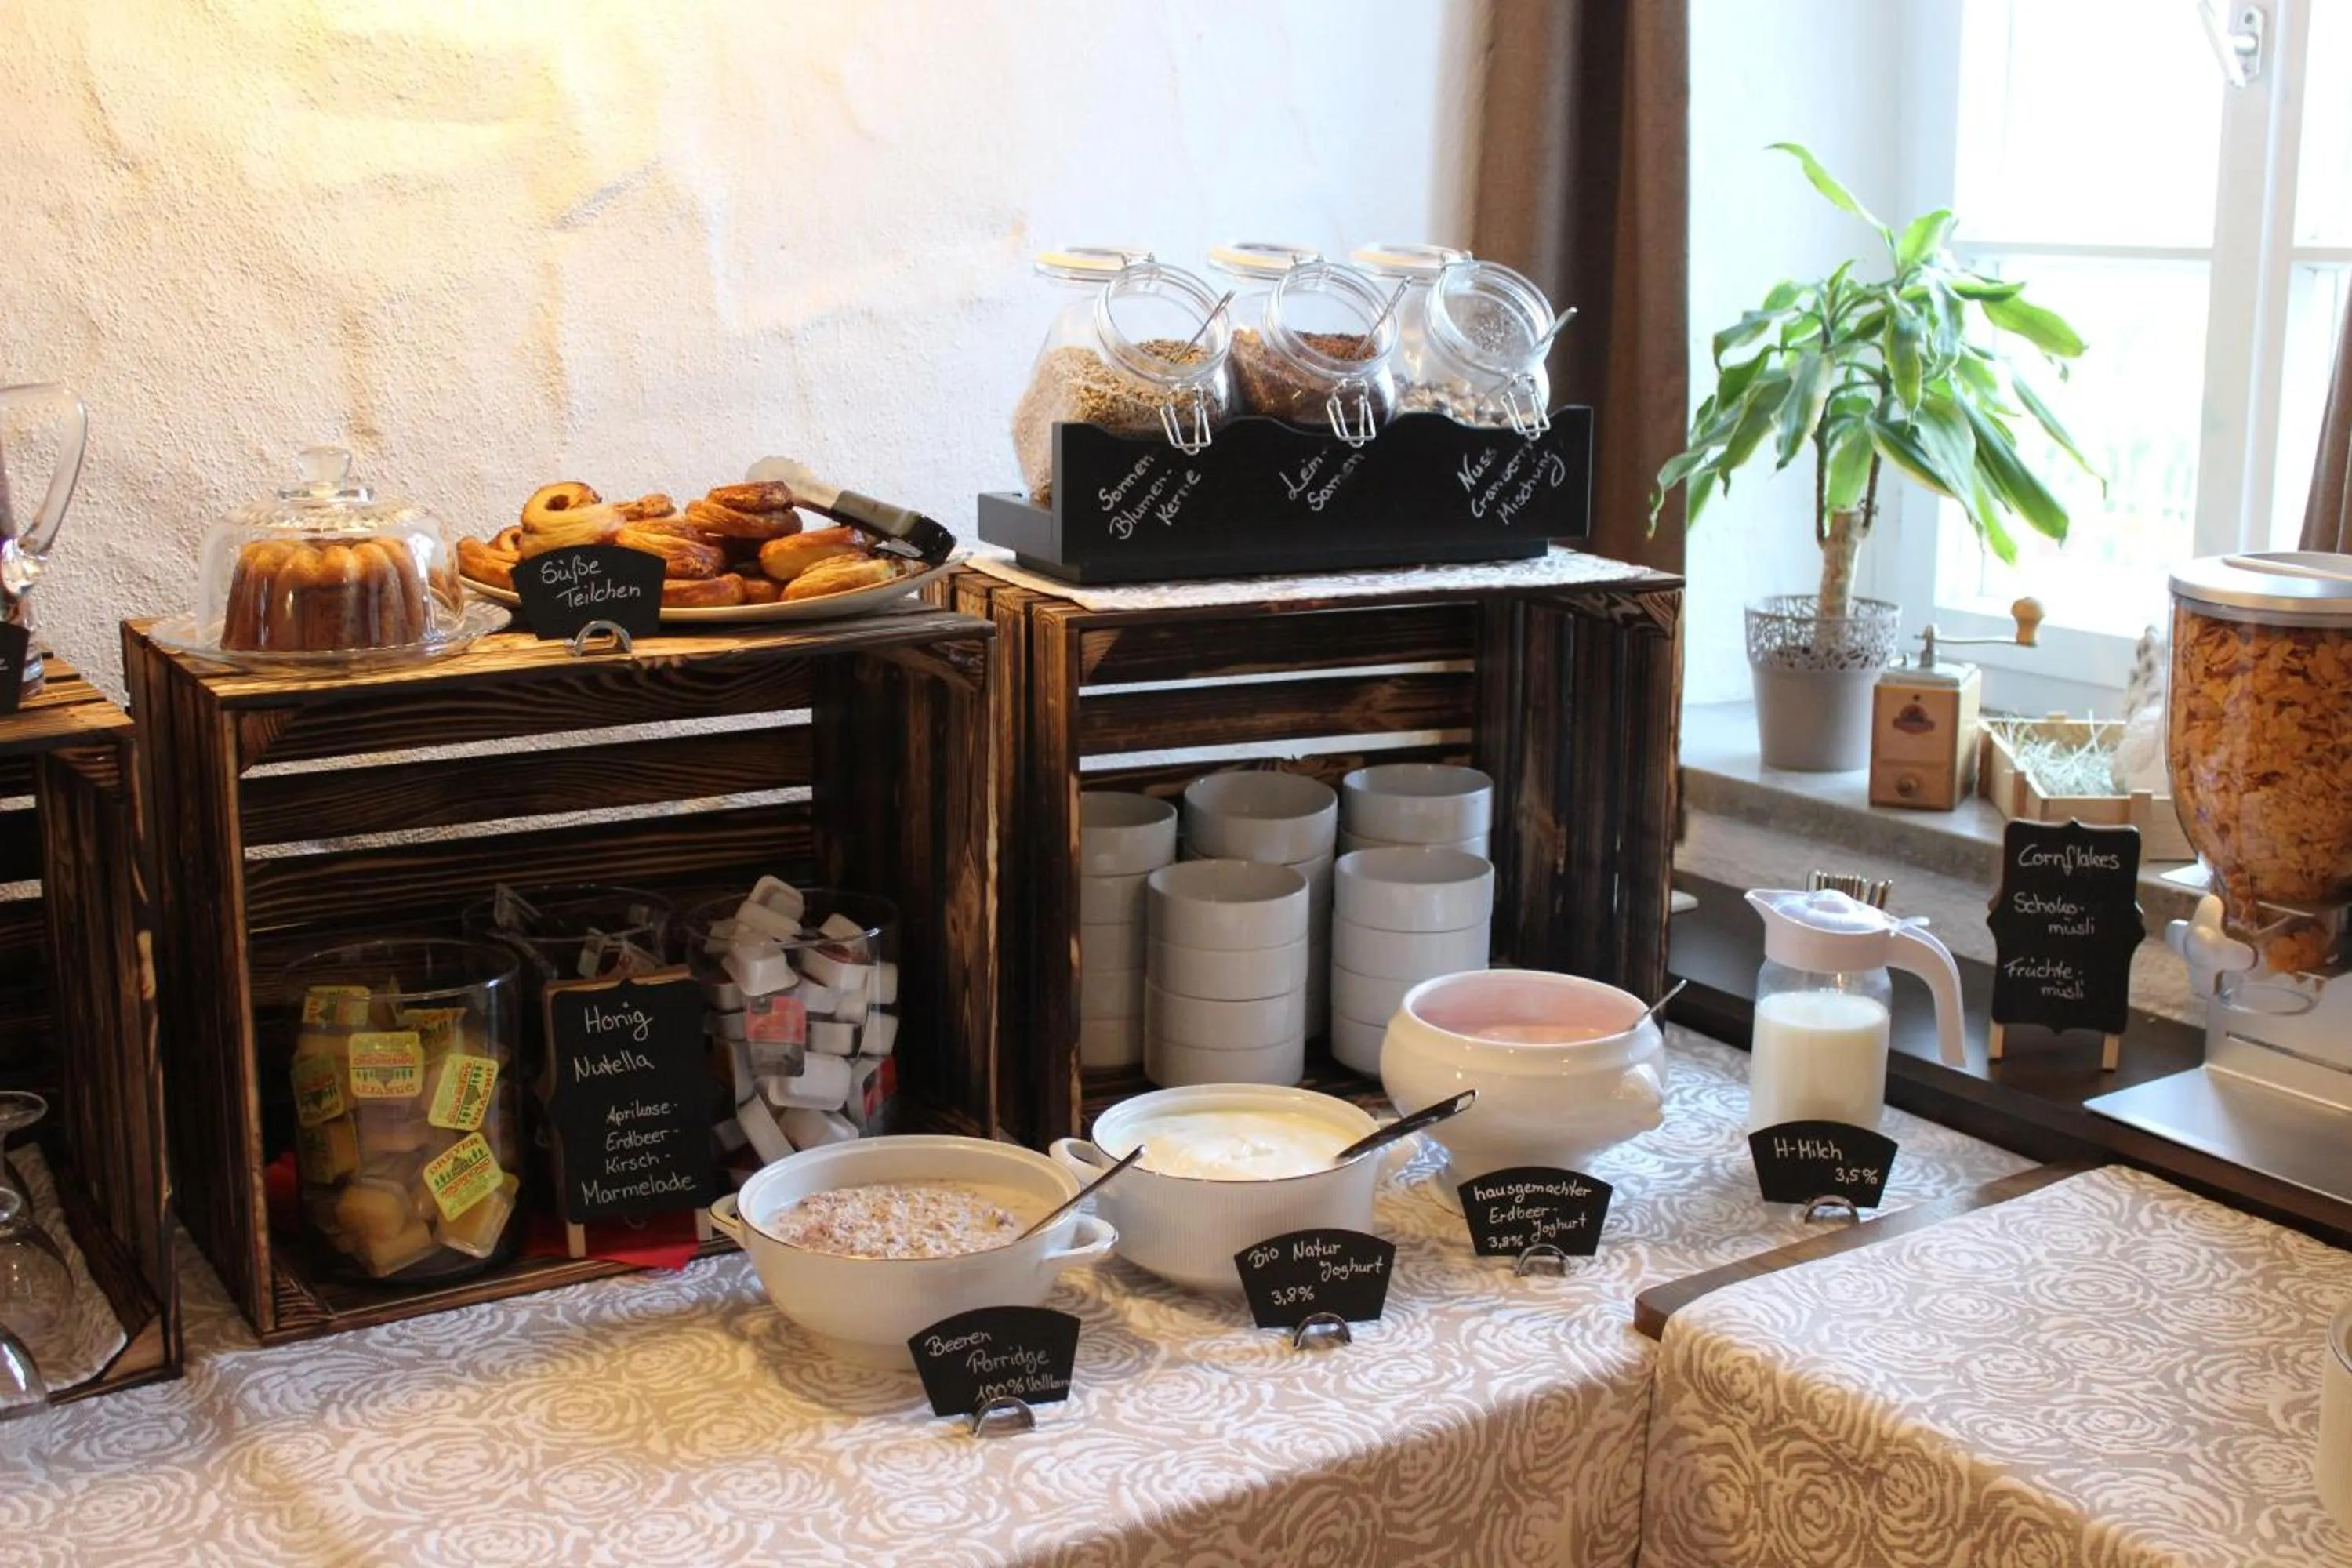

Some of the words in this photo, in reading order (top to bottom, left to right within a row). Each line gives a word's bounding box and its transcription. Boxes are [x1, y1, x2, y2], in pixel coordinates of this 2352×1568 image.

[1155, 469, 1202, 527] Kerne
[540, 554, 603, 585] Süße
[556, 578, 641, 608] Teilchen
[2017, 843, 2121, 877] Cornflakes
[2048, 916, 2096, 935] müsli
[2041, 979, 2085, 1000] müsli
[584, 1000, 654, 1042] Honig
[573, 1049, 656, 1083] Nutella
[1773, 1137, 1842, 1161] H-Milch
[580, 1172, 698, 1207] Marmelade
[1473, 1178, 1592, 1203] hausgemachter
[1834, 1167, 1878, 1185] 3,5%
[1247, 1246, 1280, 1269] Bio
[1293, 1237, 1342, 1261] Natur
[1486, 1234, 1524, 1250] 3,8%
[1271, 1283, 1316, 1305] 3,8%
[924, 1331, 993, 1357] Beeren
[965, 1345, 1051, 1374] Porridge
